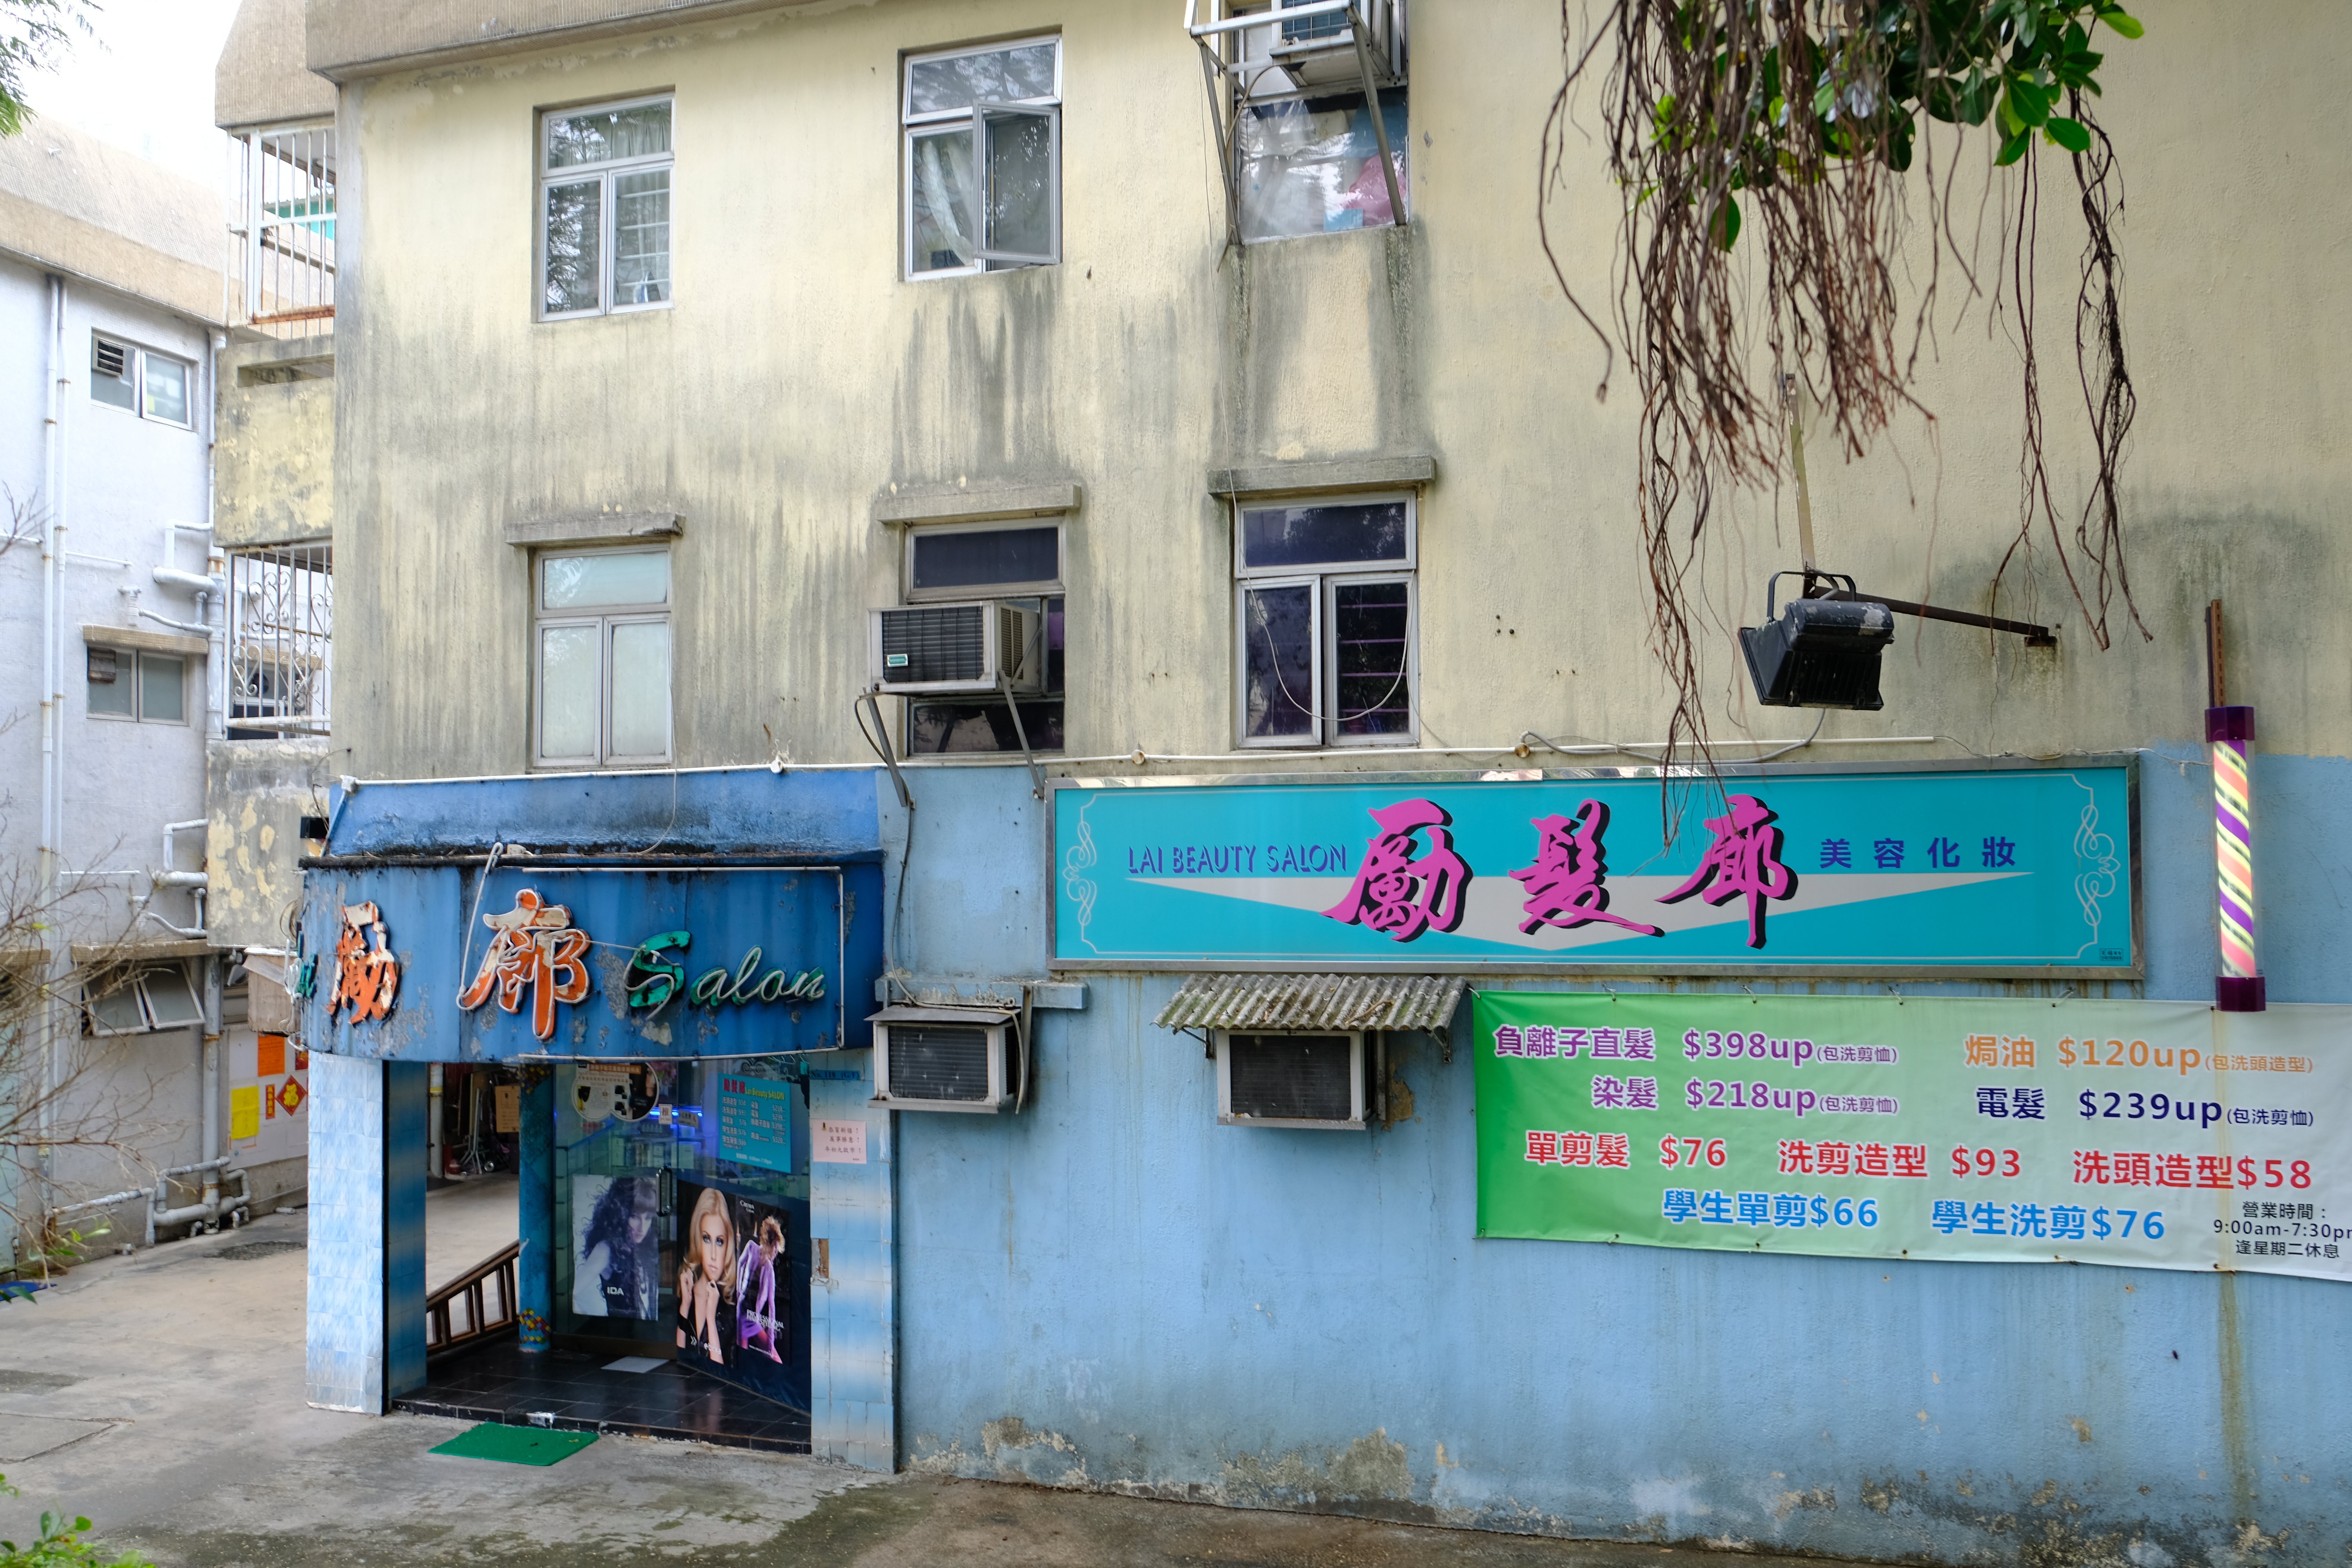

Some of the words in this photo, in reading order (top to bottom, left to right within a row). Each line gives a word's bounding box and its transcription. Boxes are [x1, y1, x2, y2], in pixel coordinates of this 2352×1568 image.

[1128, 845, 1164, 874] LAI
[1172, 844, 1256, 873] BEAUTY
[1267, 843, 1347, 873] SALON
[1819, 836, 2016, 869] 美容化妝
[625, 931, 826, 1020] Salon
[1494, 1025, 1654, 1060] 負離子直髮
[1684, 1029, 1813, 1066] $398up
[1965, 1034, 2035, 1068] 焗油
[2058, 1037, 2201, 1074] $120up
[2205, 1054, 2314, 1073] (包洗頭造型)
[1592, 1076, 1658, 1110] 染髮
[1686, 1079, 1815, 1116] $218up
[1976, 1087, 2046, 1120] 電髮
[2079, 1089, 2222, 1129] $239up
[1526, 1131, 1630, 1168] 單剪髮
[1659, 1135, 1726, 1169] $76
[1777, 1140, 1928, 1178] 洗剪造型
[1951, 1145, 2021, 1178] $93
[2236, 1240, 2339, 1258] 逢星期二休息
[607, 1287, 624, 1296] IDA
